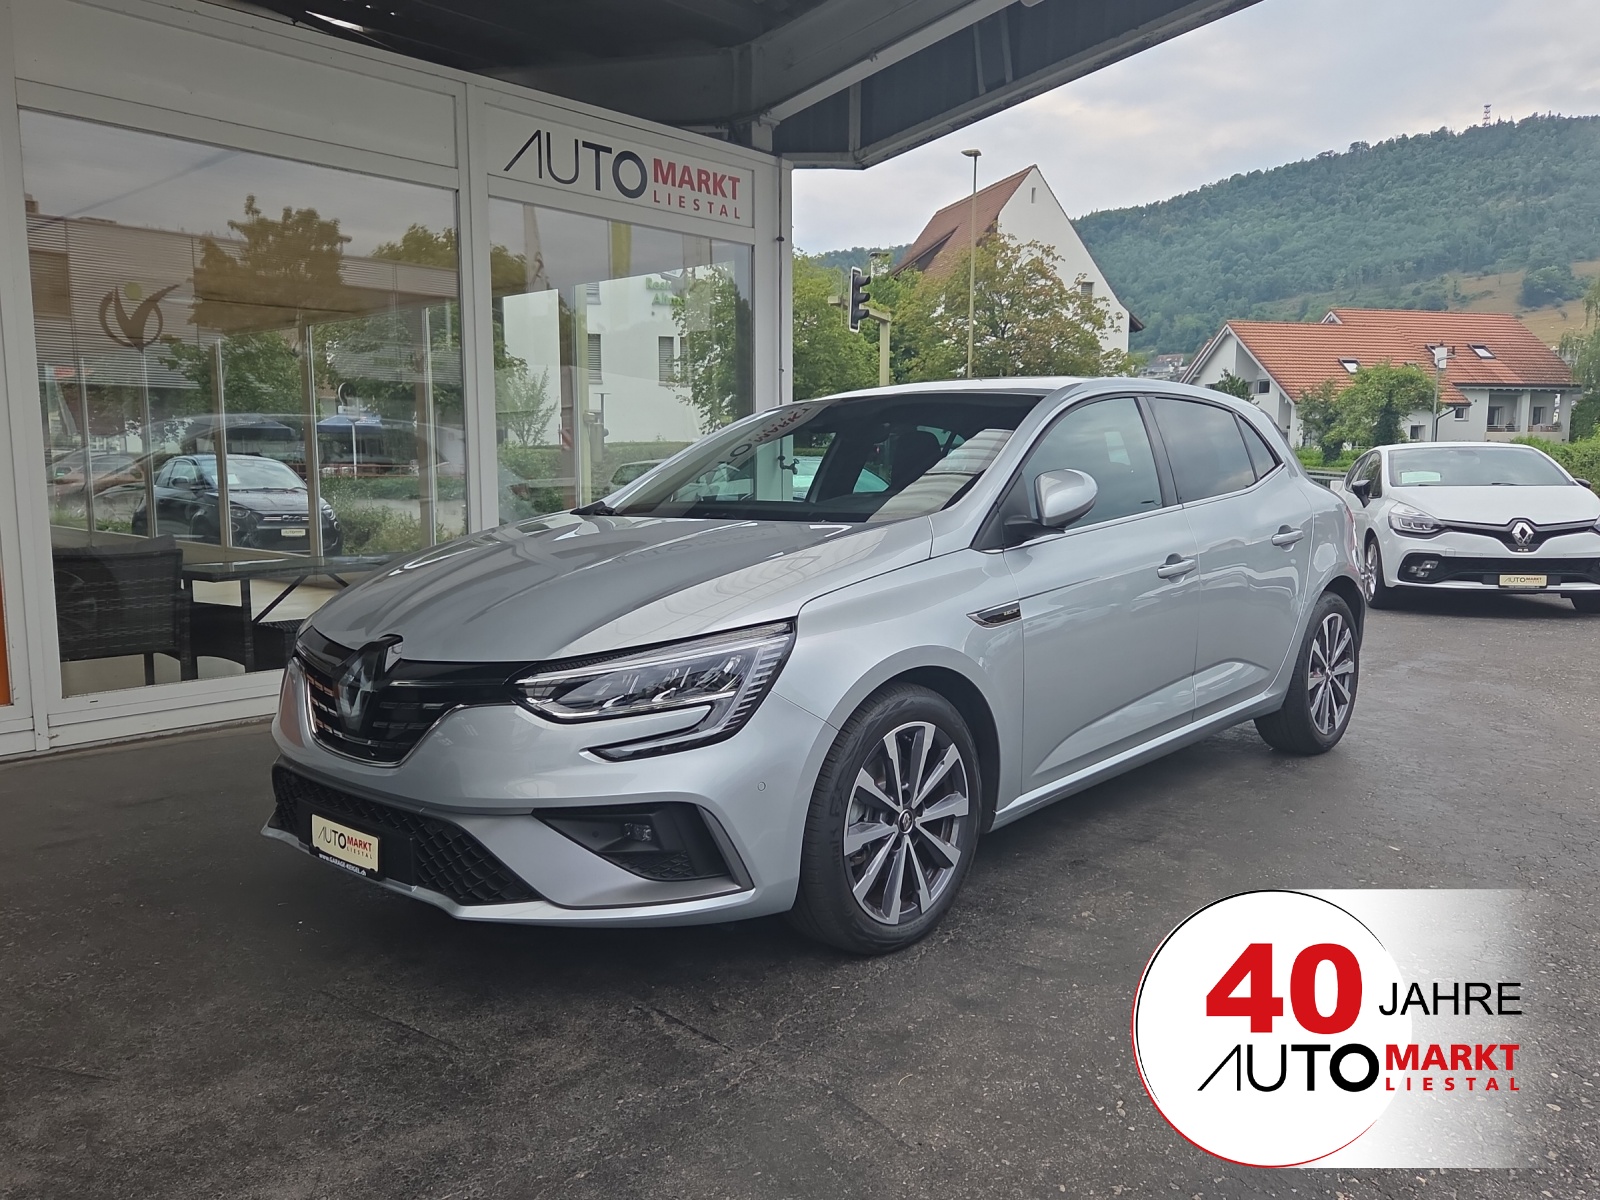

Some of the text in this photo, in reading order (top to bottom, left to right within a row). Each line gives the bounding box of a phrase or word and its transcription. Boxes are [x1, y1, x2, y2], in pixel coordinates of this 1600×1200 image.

[503, 129, 741, 200] AUTO MARKT
[653, 189, 741, 220] LIESTAL
[318, 827, 372, 853] AUTO MARKT
[347, 846, 373, 860] LIESTAL
